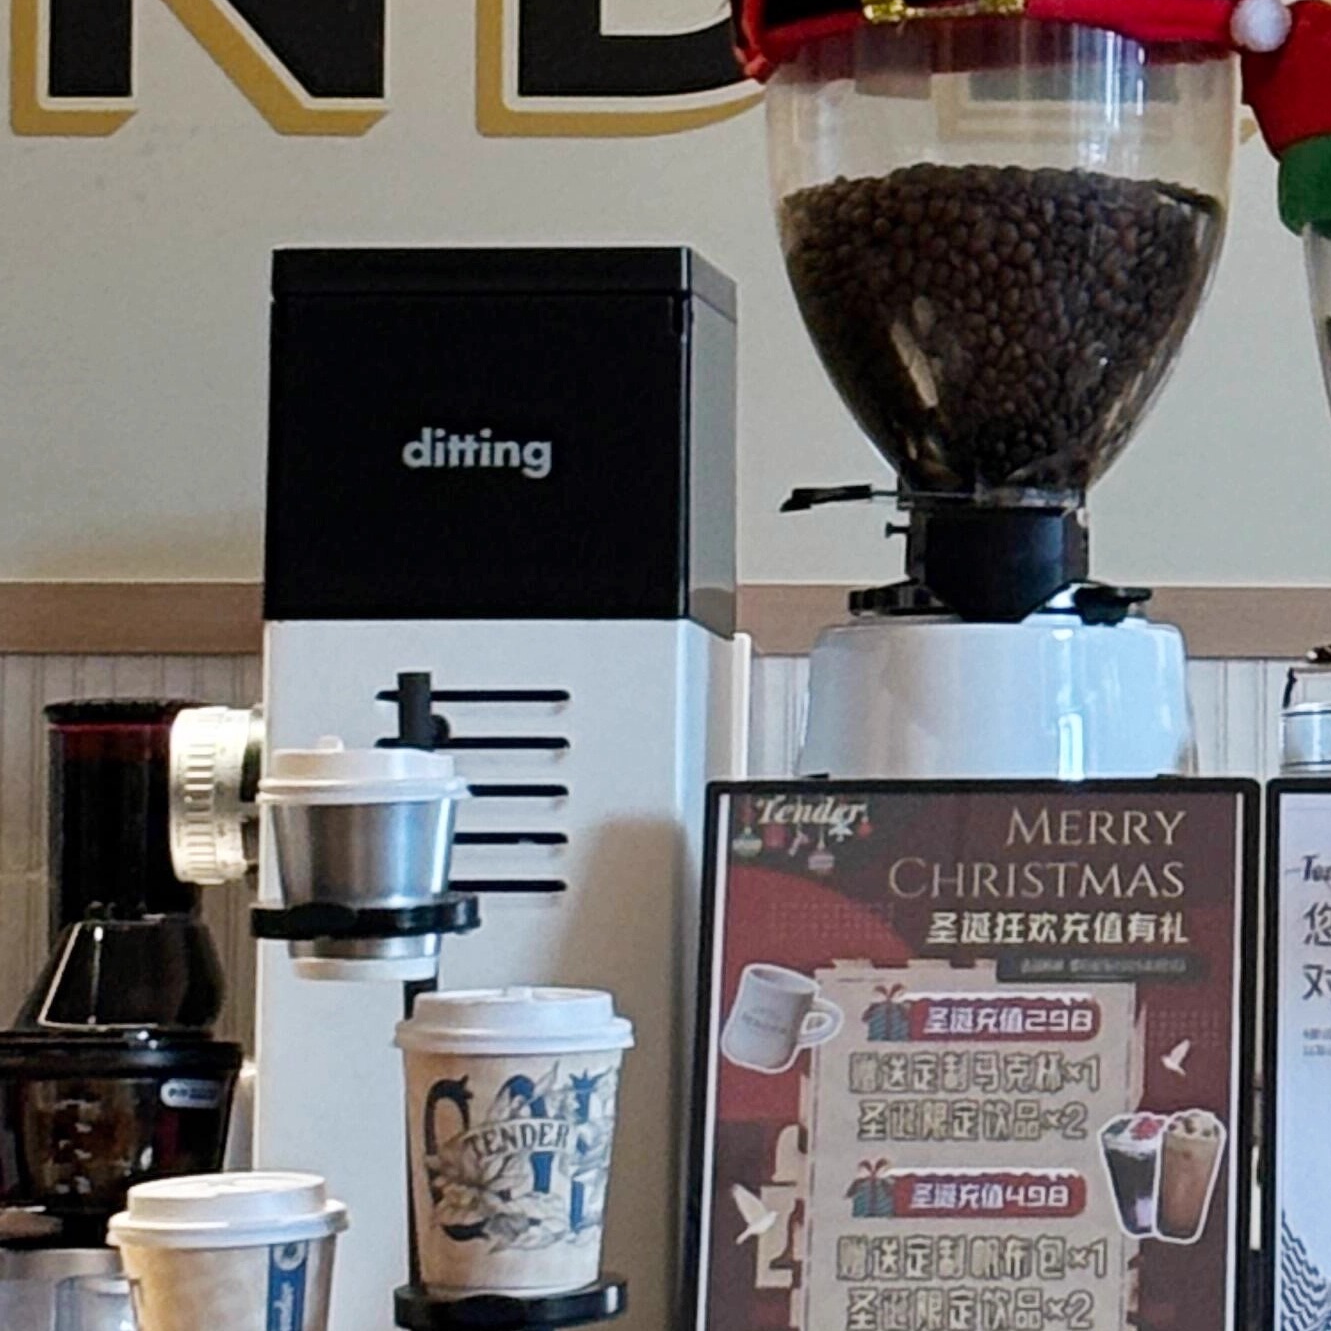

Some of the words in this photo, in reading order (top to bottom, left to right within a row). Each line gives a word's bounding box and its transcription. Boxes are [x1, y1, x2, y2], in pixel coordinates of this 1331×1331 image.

[402, 426, 553, 479] ditting
[756, 794, 868, 825] Tender
[1005, 807, 1187, 846] MERRY
[888, 856, 1186, 899] CHRISTMAS
[925, 910, 1190, 945] 圣诞狂欢充值有礼
[922, 1006, 1095, 1034] 圣诞充值298
[463, 1121, 571, 1159] TENDER
[909, 1183, 1070, 1210] 圣诞充值498
